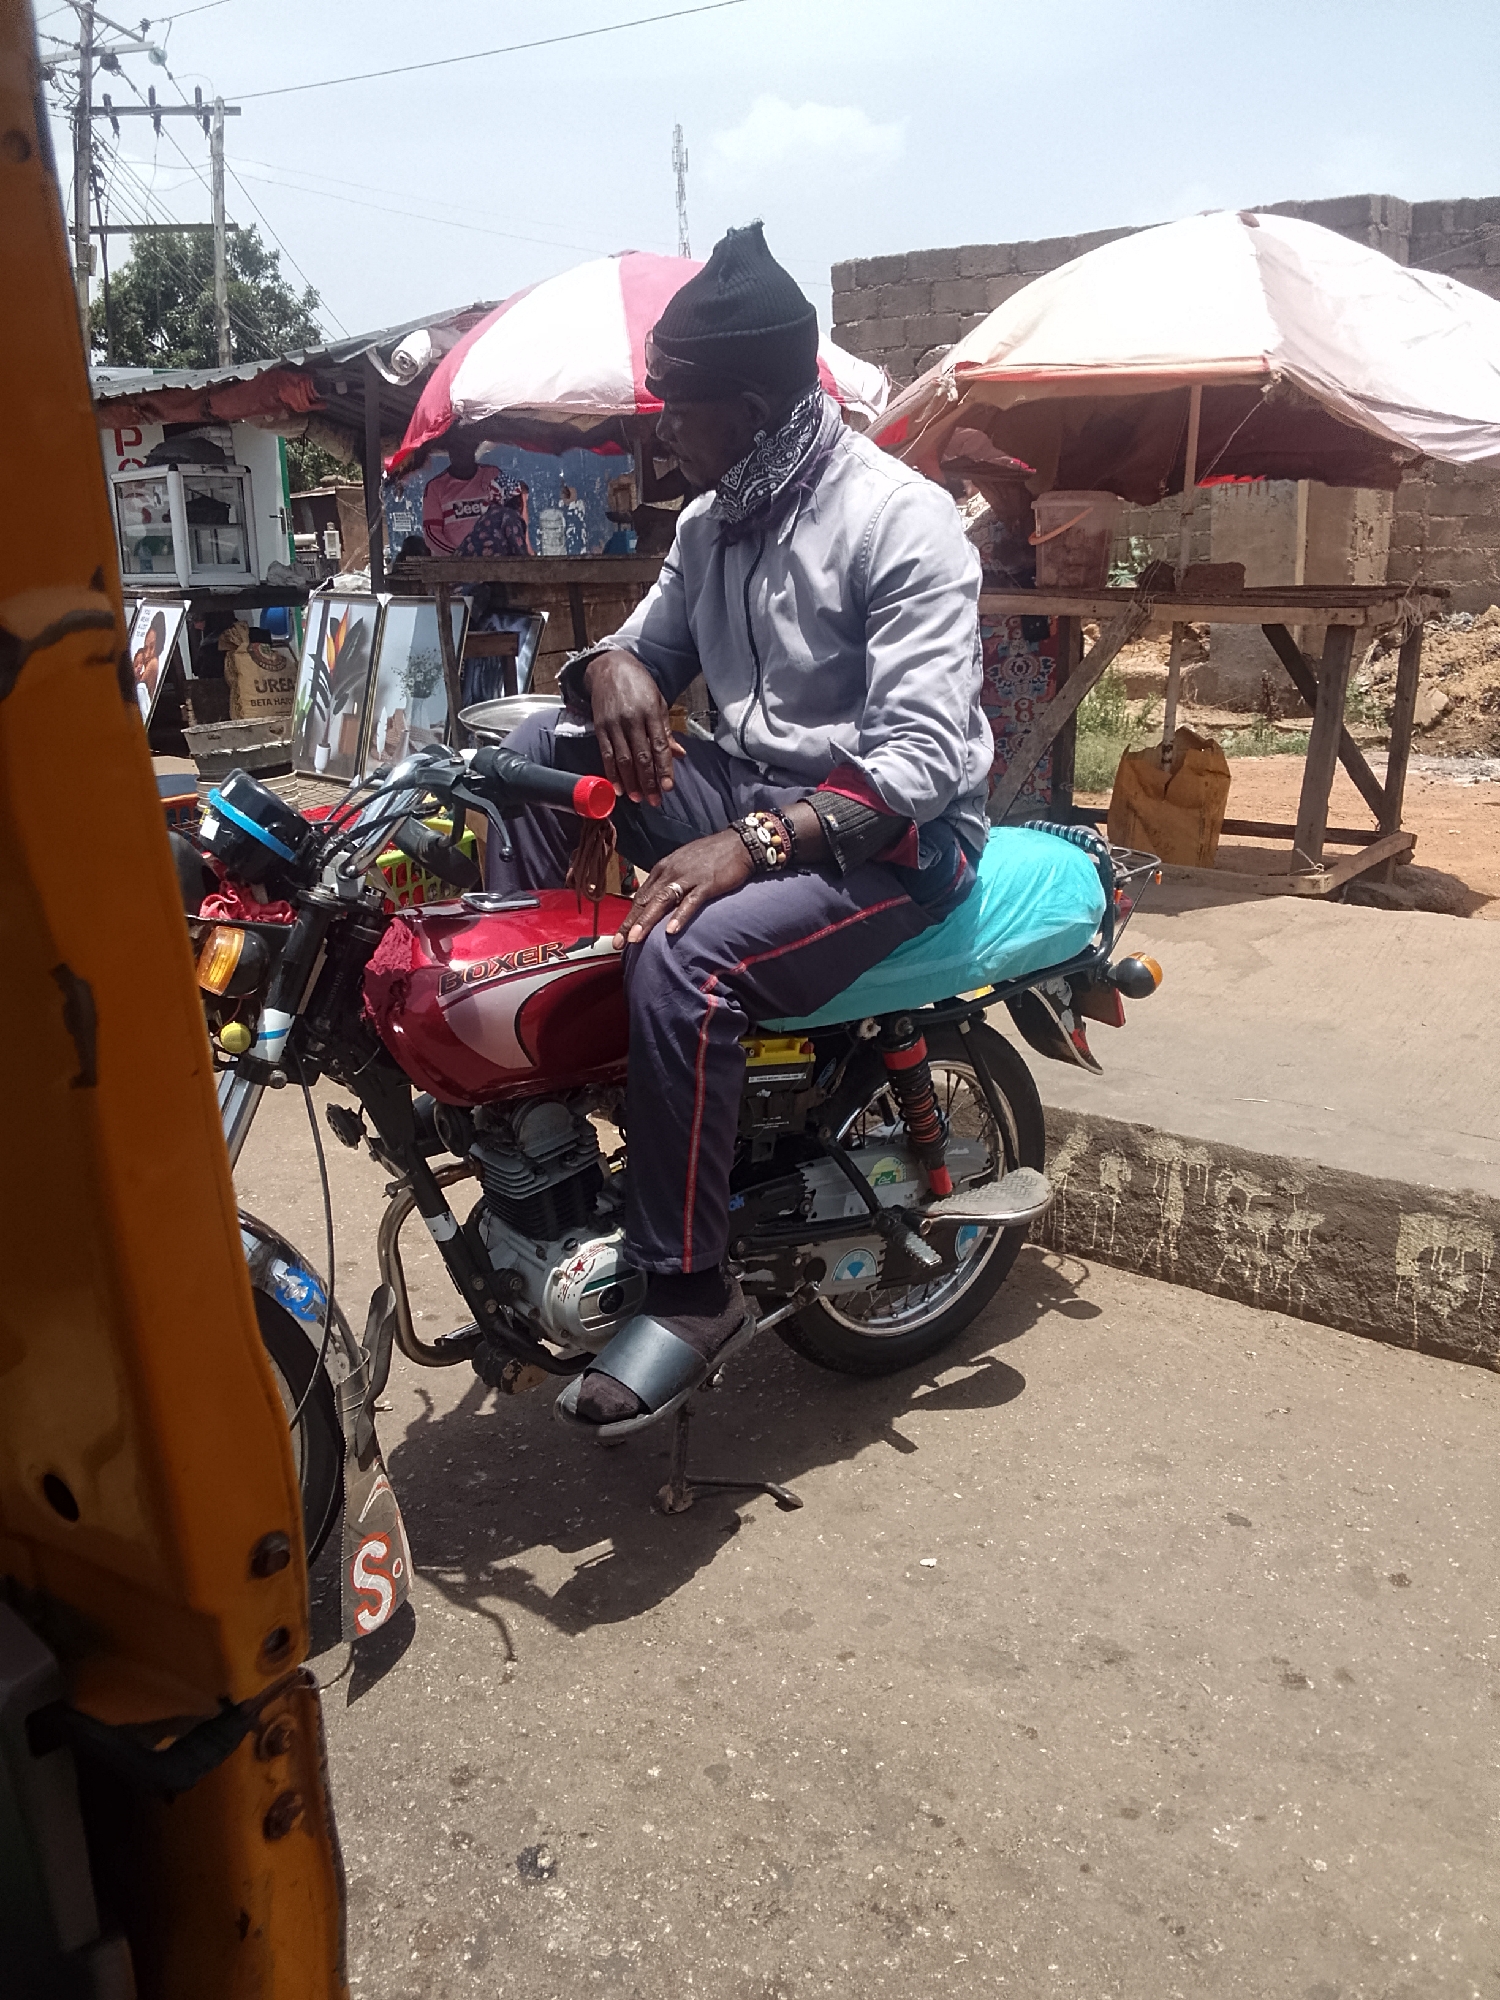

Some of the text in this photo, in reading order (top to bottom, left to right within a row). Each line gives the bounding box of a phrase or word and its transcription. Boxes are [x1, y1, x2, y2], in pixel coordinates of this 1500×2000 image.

[253, 677, 295, 693] UREA
[251, 699, 273, 707] BETA
[438, 941, 569, 998] BOXER
